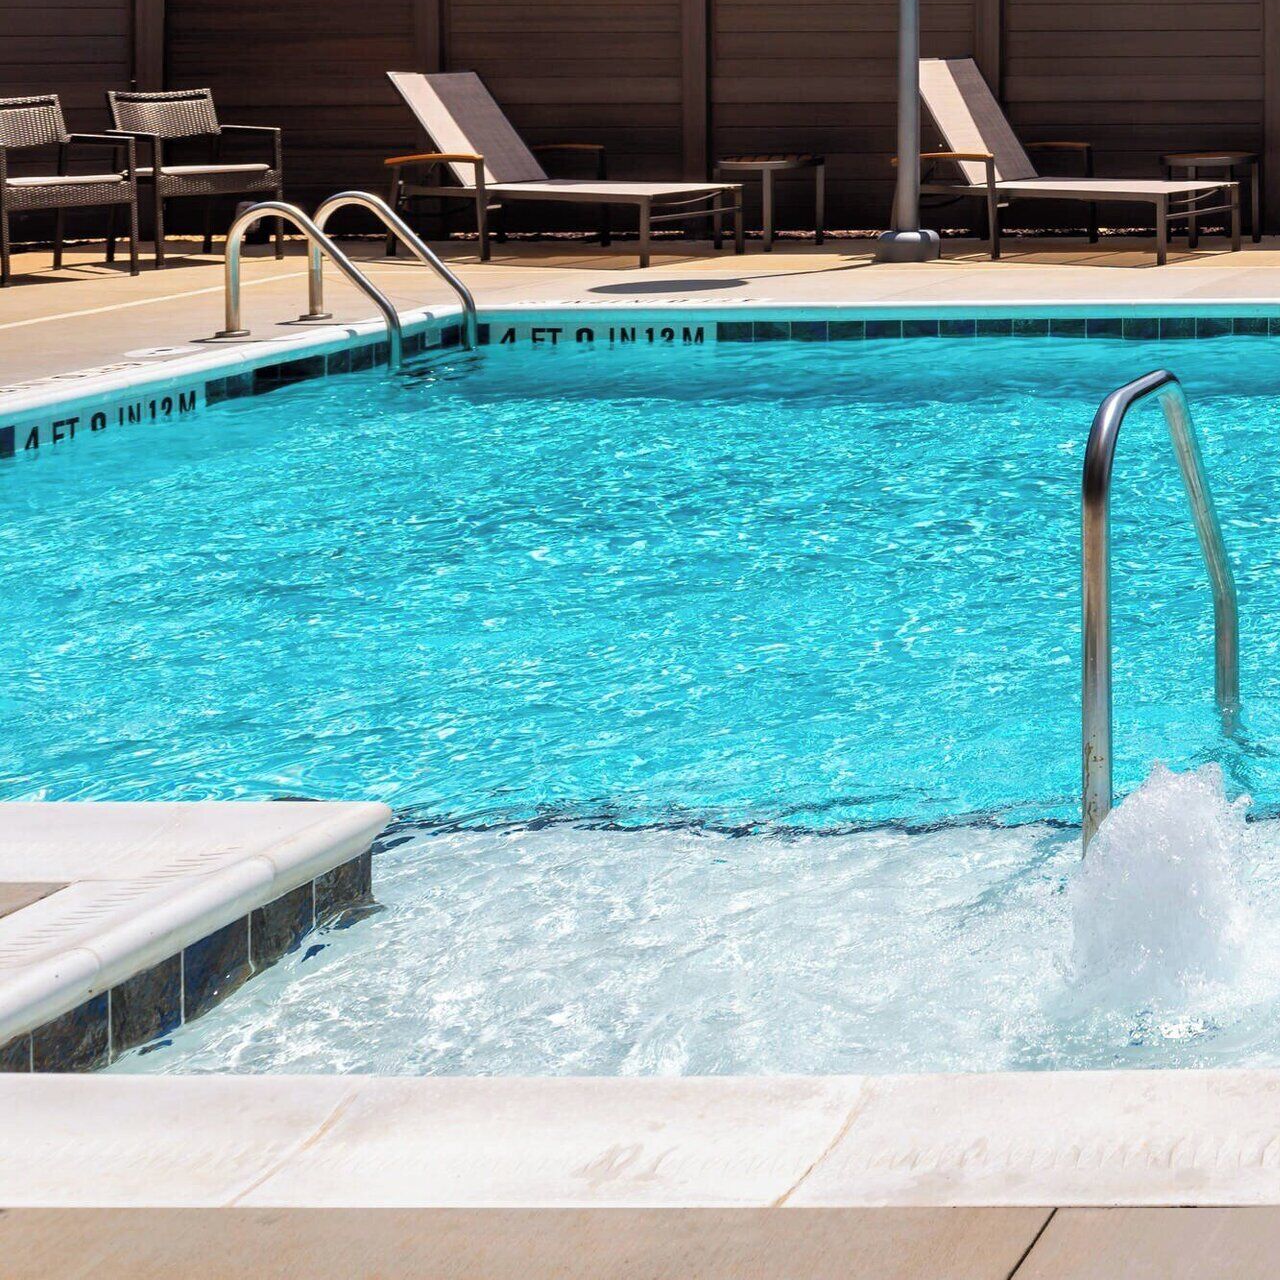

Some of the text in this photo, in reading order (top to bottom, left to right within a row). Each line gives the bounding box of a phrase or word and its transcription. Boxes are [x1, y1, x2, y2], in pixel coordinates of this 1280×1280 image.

[499, 327, 516, 345] 4
[531, 327, 563, 345] FT
[609, 327, 636, 343] IN
[24, 425, 39, 450] 4
[52, 416, 80, 445] FT
[118, 402, 141, 426] IN
